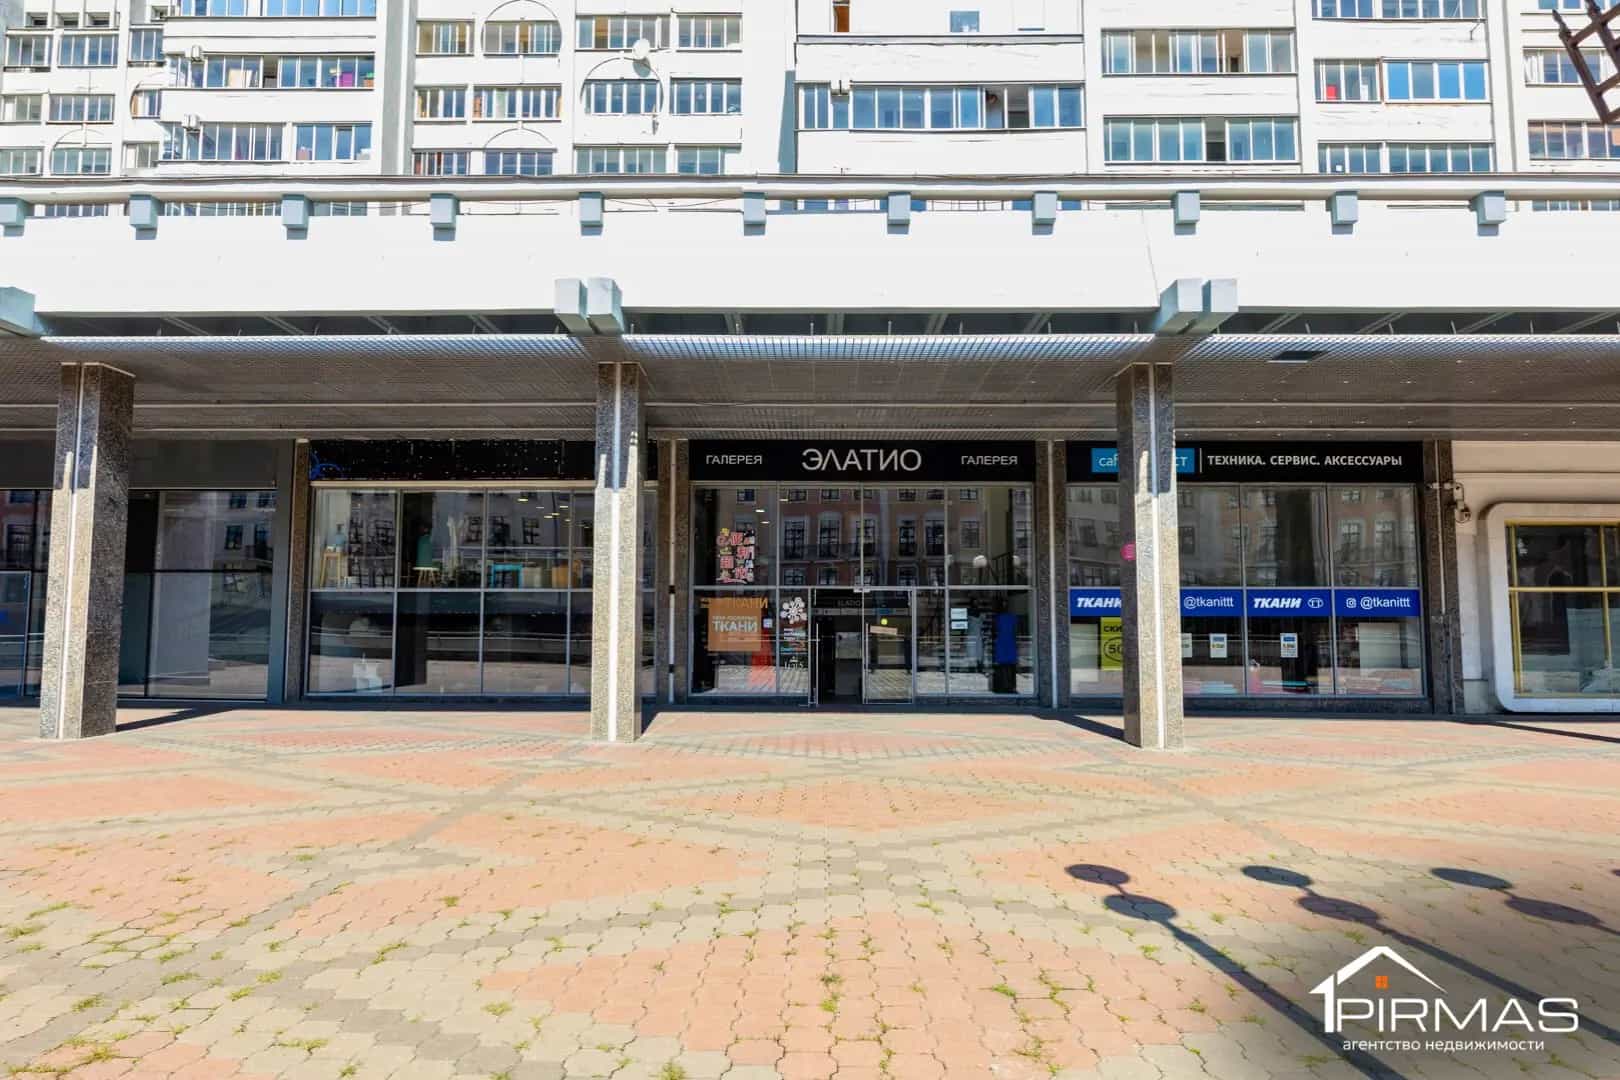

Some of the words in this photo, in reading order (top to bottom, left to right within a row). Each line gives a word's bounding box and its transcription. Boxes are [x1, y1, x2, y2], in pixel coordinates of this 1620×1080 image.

[706, 455, 763, 465] ГАЛЕРЕЯ
[802, 449, 922, 471] ЭЛАТИО
[961, 455, 1018, 465] ГАЛЕРЕЯ
[1207, 455, 1266, 466] ТЕХНИКА.
[1270, 455, 1321, 466] СЕРВИС.
[1324, 455, 1402, 466] АКСЕССУАРЫ
[1253, 597, 1303, 609] ТКАНИ
[712, 620, 758, 633] ТКАНИ
